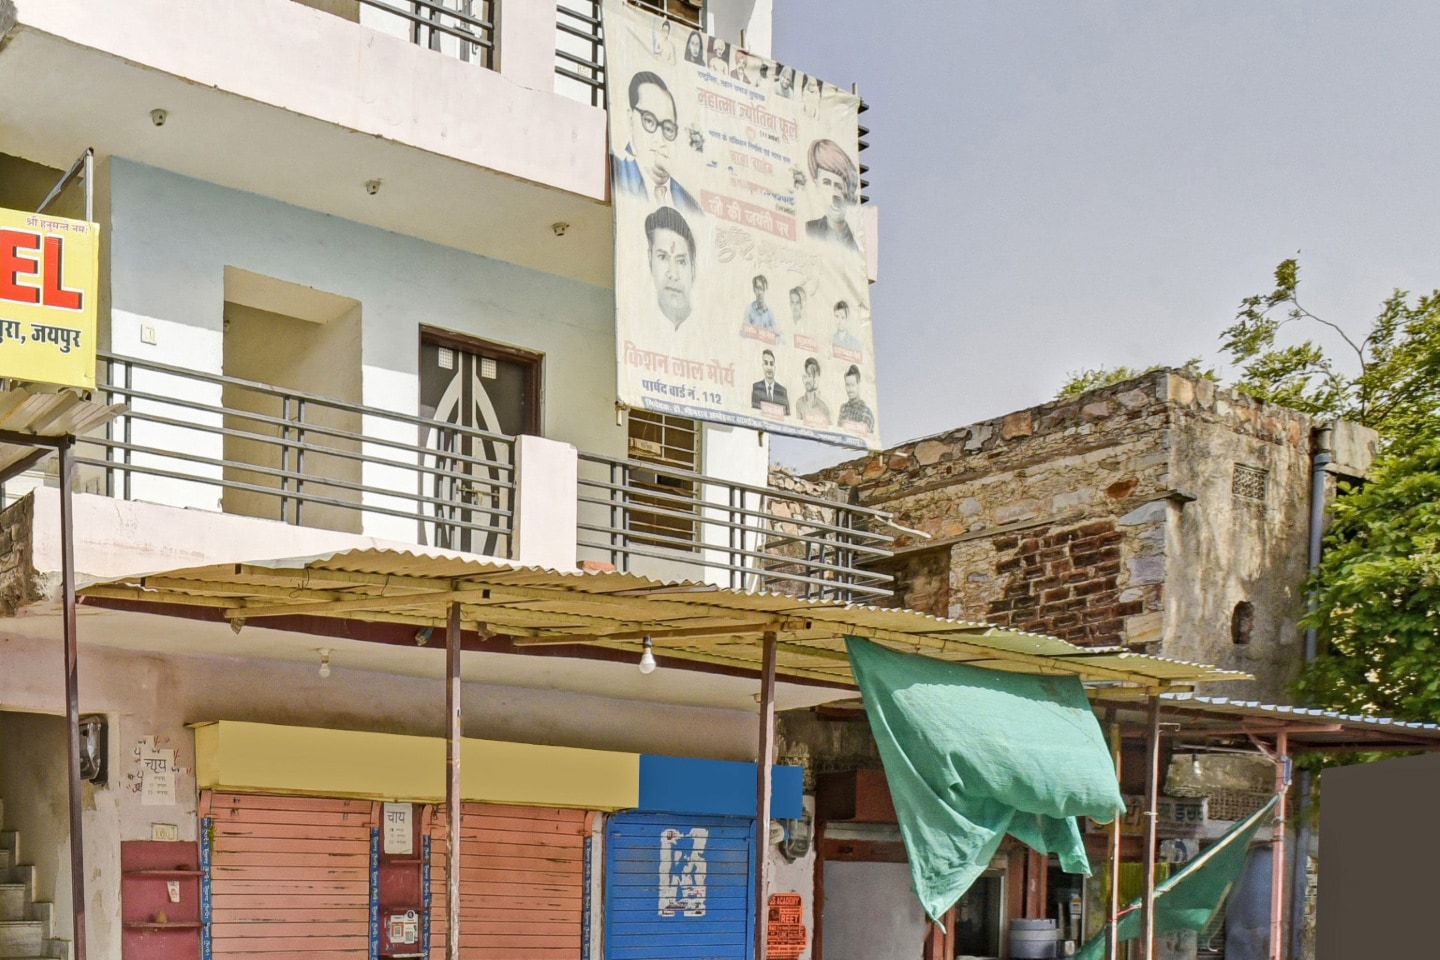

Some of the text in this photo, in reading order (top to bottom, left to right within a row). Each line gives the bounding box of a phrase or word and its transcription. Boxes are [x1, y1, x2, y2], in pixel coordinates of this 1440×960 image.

[696, 87, 736, 116] महात्मा
[738, 101, 777, 130] ज्योतिबा
[27, 216, 38, 226] श्री
[708, 196, 723, 217] जी
[726, 201, 741, 222] की
[744, 210, 773, 233] जयंती
[776, 220, 790, 237] पर
[31, 323, 81, 353] जयपुर
[624, 340, 736, 387] किशन लाल मौर्य
[642, 379, 667, 395] पार्षद
[668, 384, 686, 398] वार्ड
[702, 391, 722, 405] 112
[387, 811, 406, 824] चाय
[777, 896, 799, 906] ACADEMY
[781, 914, 799, 923] REET
